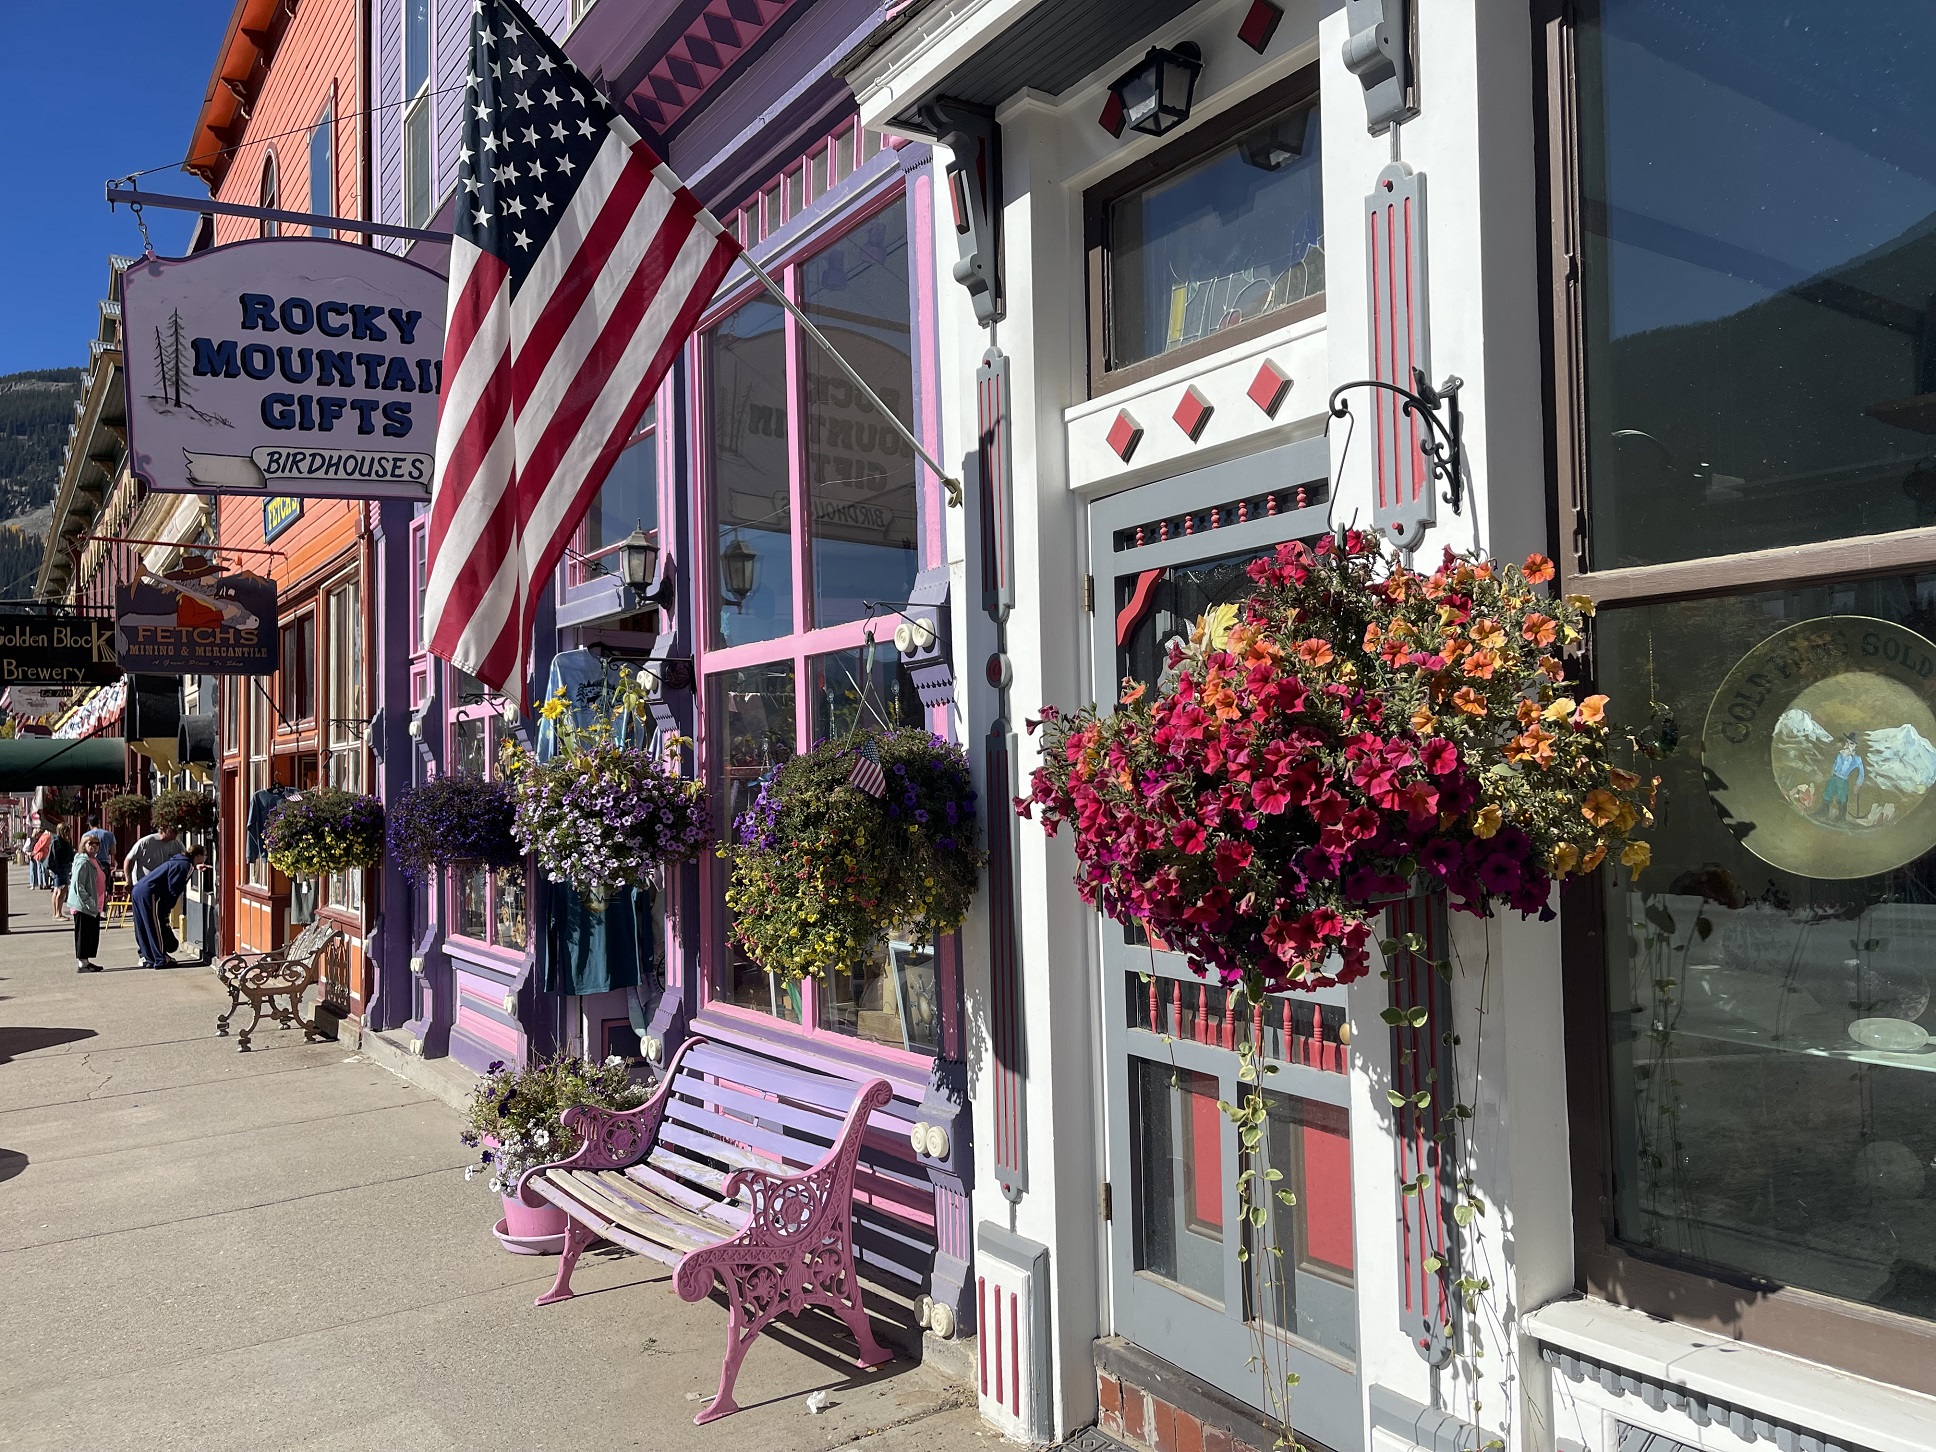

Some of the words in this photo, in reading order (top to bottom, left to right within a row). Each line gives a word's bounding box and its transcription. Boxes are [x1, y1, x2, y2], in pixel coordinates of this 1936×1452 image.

[239, 293, 422, 345] ROCKY
[261, 392, 413, 439] GIFTS
[263, 450, 425, 480] BIRDHOUSES
[3, 658, 85, 683] Brewery
[129, 645, 175, 656] MINING
[180, 646, 190, 656] &
[195, 646, 268, 658] MERCANTILE
[1861, 632, 1935, 678] SOLD
